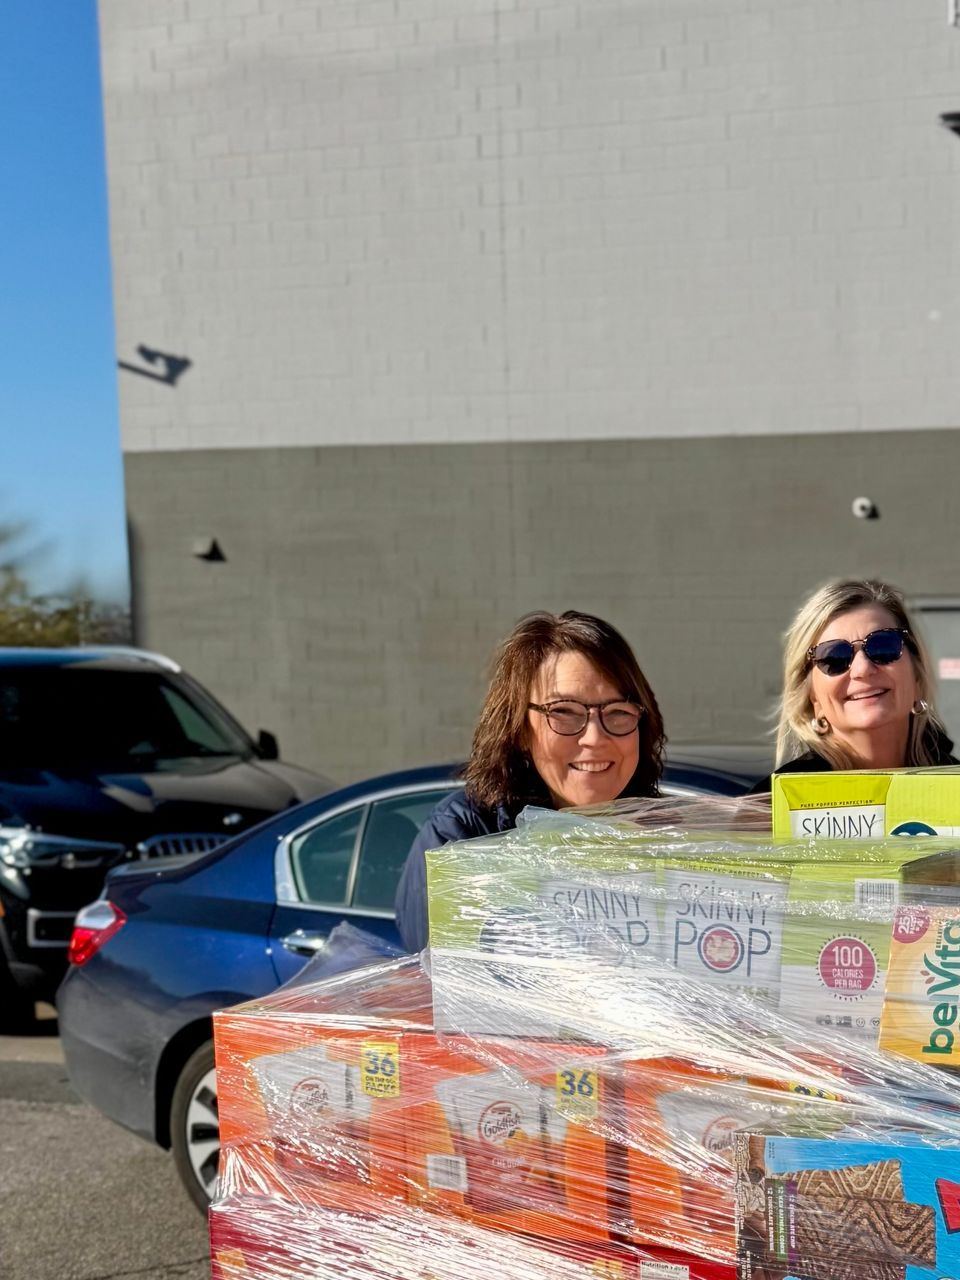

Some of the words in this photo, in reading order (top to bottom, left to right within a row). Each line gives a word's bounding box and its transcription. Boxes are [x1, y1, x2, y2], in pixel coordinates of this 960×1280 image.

[830, 945, 863, 968] 100
[831, 968, 865, 981] CALORIES
[834, 979, 849, 990] PER
[849, 979, 863, 991] BAG
[364, 1050, 397, 1079] 36
[559, 1069, 594, 1098] 36
